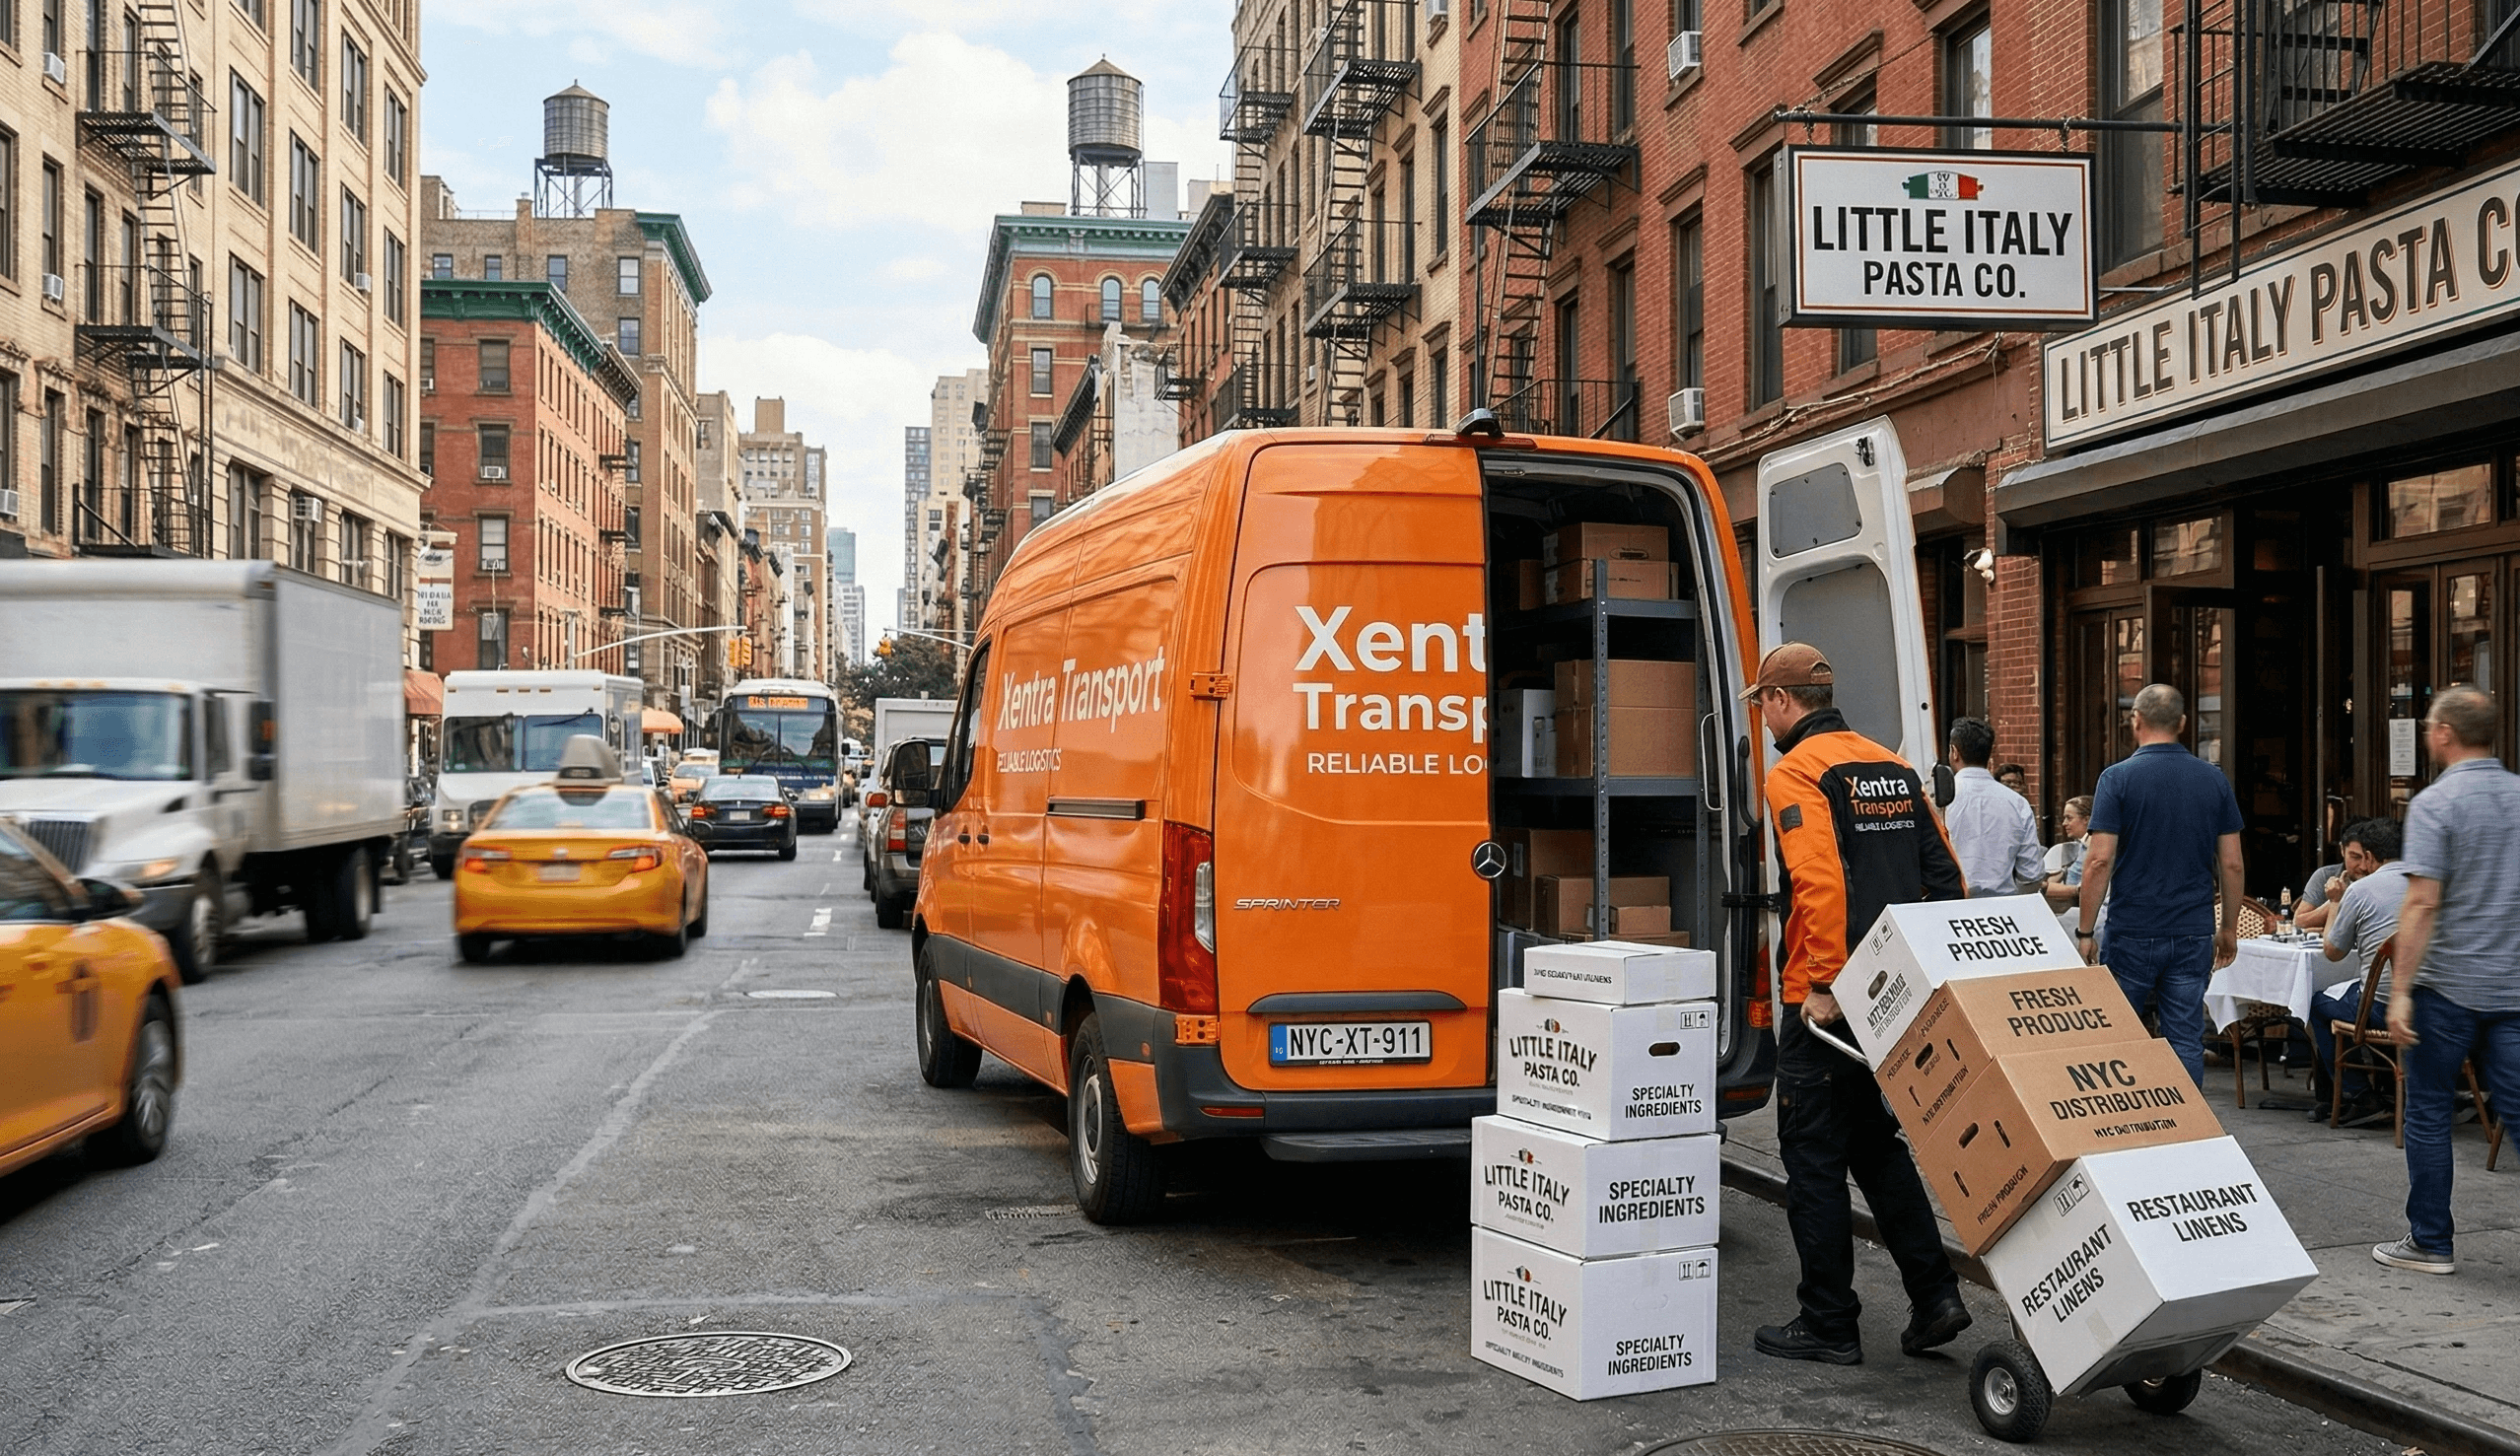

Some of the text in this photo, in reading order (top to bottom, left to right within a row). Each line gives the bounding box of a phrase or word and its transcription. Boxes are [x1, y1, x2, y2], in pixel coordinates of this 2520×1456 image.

[1812, 206, 2072, 256] LITTLE ITALY
[1864, 260, 2026, 299] PASTA CO.
[2061, 196, 2520, 424] LITTLE ITALY PASTA C
[1294, 605, 1486, 672] Xent
[998, 646, 1165, 733] Xentra Transport
[1307, 752, 1488, 775] RELIABLE LO
[1844, 776, 1910, 797] Xentra
[1851, 799, 1914, 818] Transport
[1233, 898, 1341, 910] SPRINTER
[1948, 915, 2020, 938] FRESH
[1947, 936, 2049, 962] PRODUCE
[2008, 987, 2083, 1011] FRESH
[2007, 1007, 2112, 1037] PRODUCE
[1291, 1027, 1421, 1057] NYC-XT-911
[1509, 1036, 1597, 1073] LITTLE ITALY
[1524, 1061, 1580, 1086] PASTA CO.
[2065, 1059, 2136, 1093] NYC
[1632, 1084, 1695, 1101] SPECIALTY
[2049, 1085, 2186, 1121] DISTRIBUTION
[1625, 1099, 1702, 1119] INGREDIENTS
[1484, 1164, 1570, 1207] LITTLE ITALY
[1609, 1176, 1696, 1201] SPECIALTY
[1498, 1190, 1531, 1215] PASTA
[1535, 1202, 1555, 1222] CO.
[1598, 1196, 1706, 1224] INGREDIENTS
[2127, 1183, 2258, 1222] RESTAURANT
[2172, 1212, 2248, 1243] LINENS
[2021, 1223, 2114, 1317] RESTAURANT
[1483, 1280, 1568, 1328] LITTLE ITALY
[2052, 1267, 2105, 1324] LINENS
[1497, 1305, 1531, 1332] PASTA
[1533, 1319, 1552, 1341] CO.
[1616, 1334, 1685, 1356] SPECIALTY
[1608, 1352, 1693, 1376] INGREDIENTS
